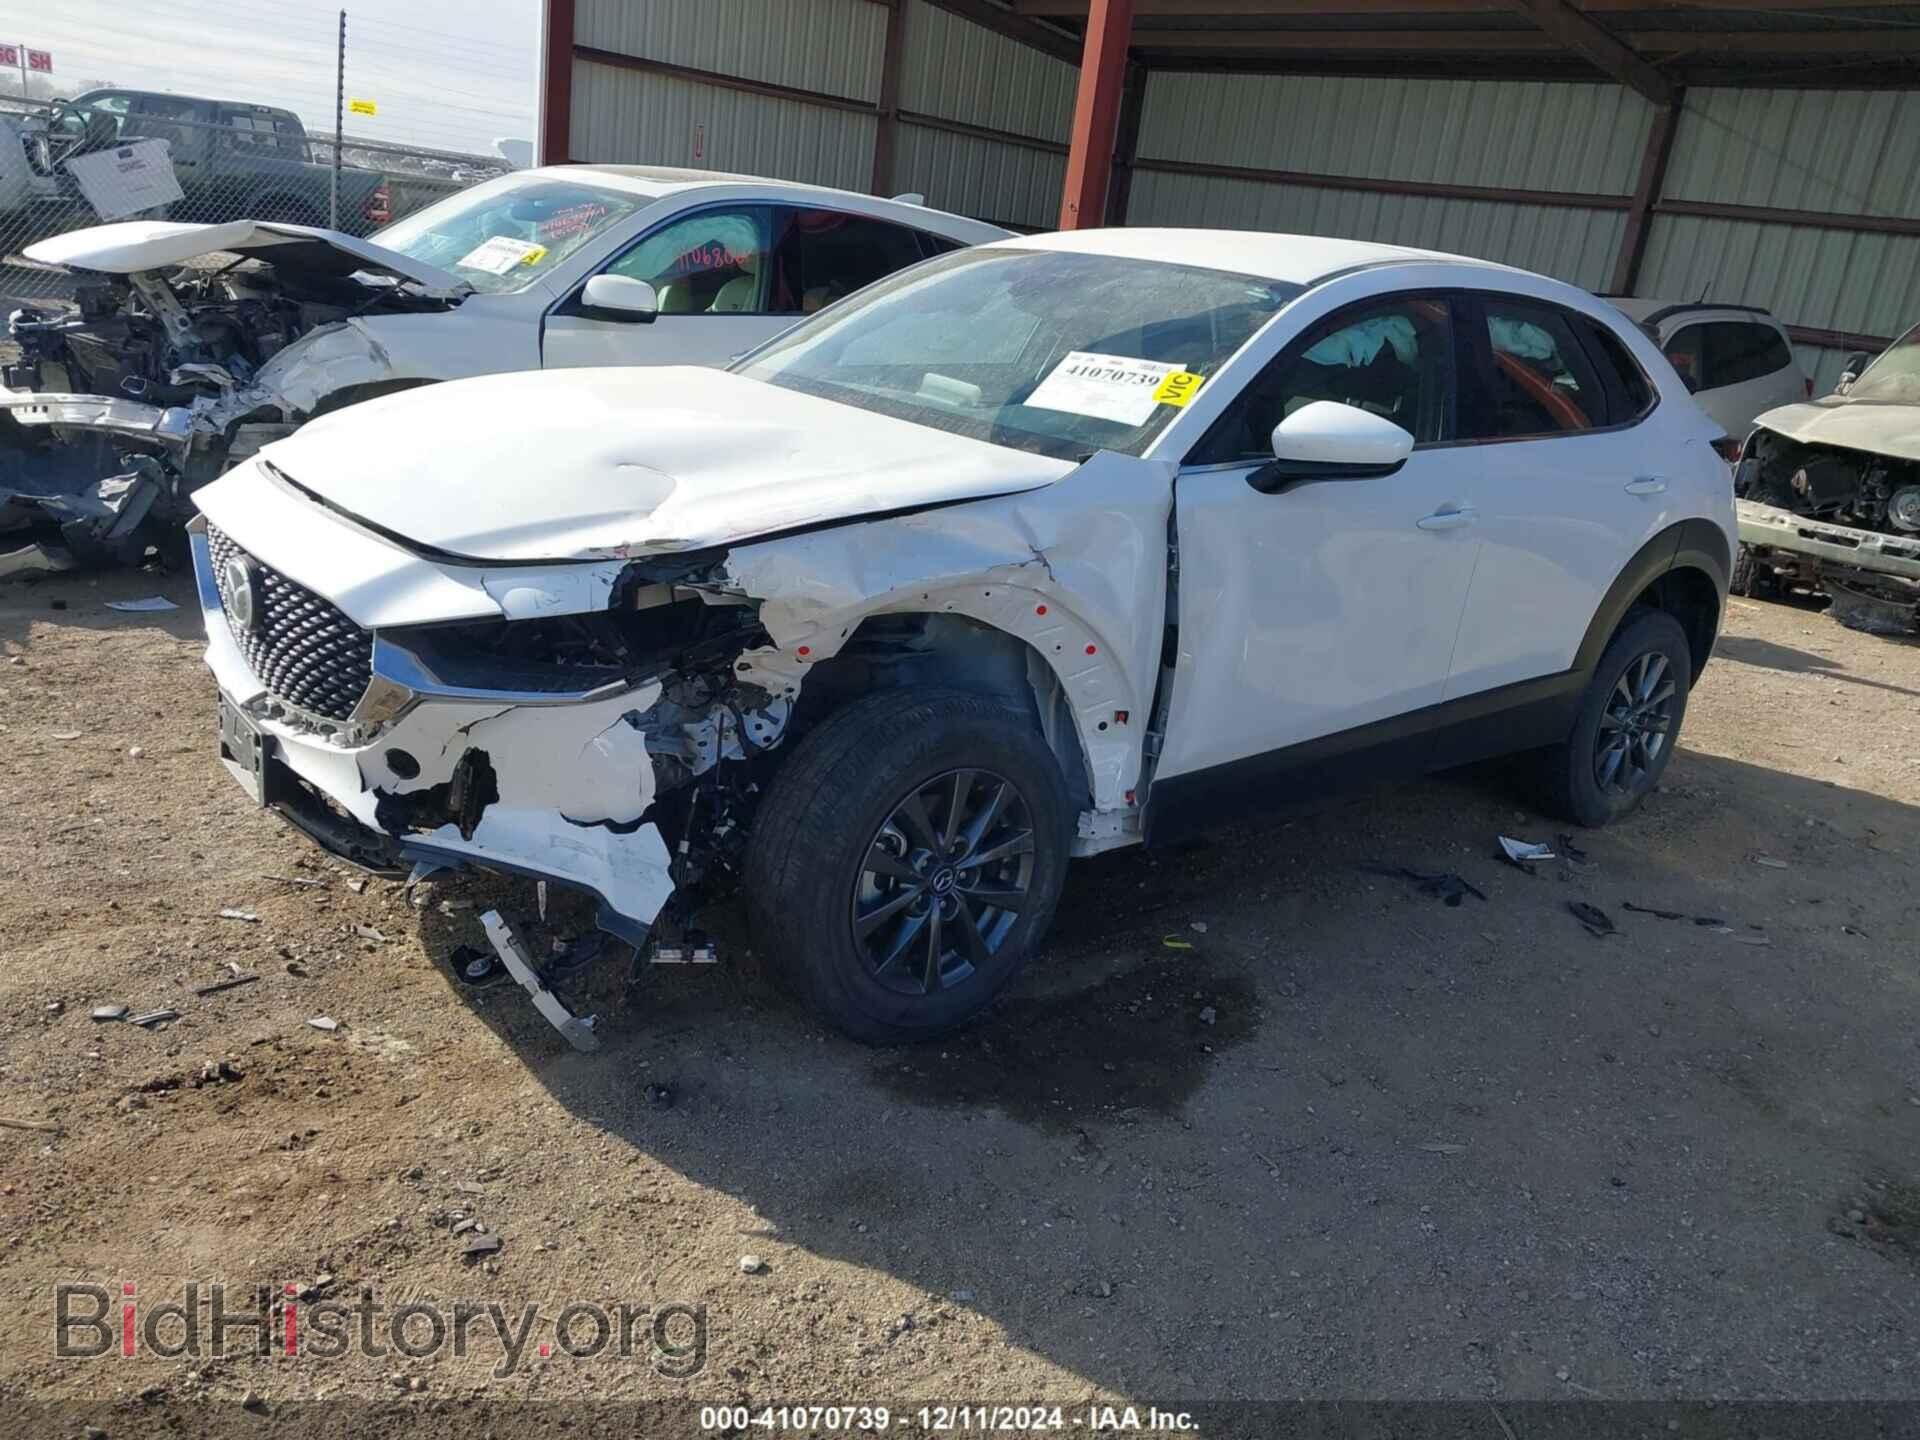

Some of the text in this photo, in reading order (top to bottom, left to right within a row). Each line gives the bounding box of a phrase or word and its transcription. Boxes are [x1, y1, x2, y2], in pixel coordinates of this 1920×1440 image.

[30, 52, 51, 70] SH
[1066, 365, 1160, 386] 41070739
[1160, 374, 1193, 400] VIC
